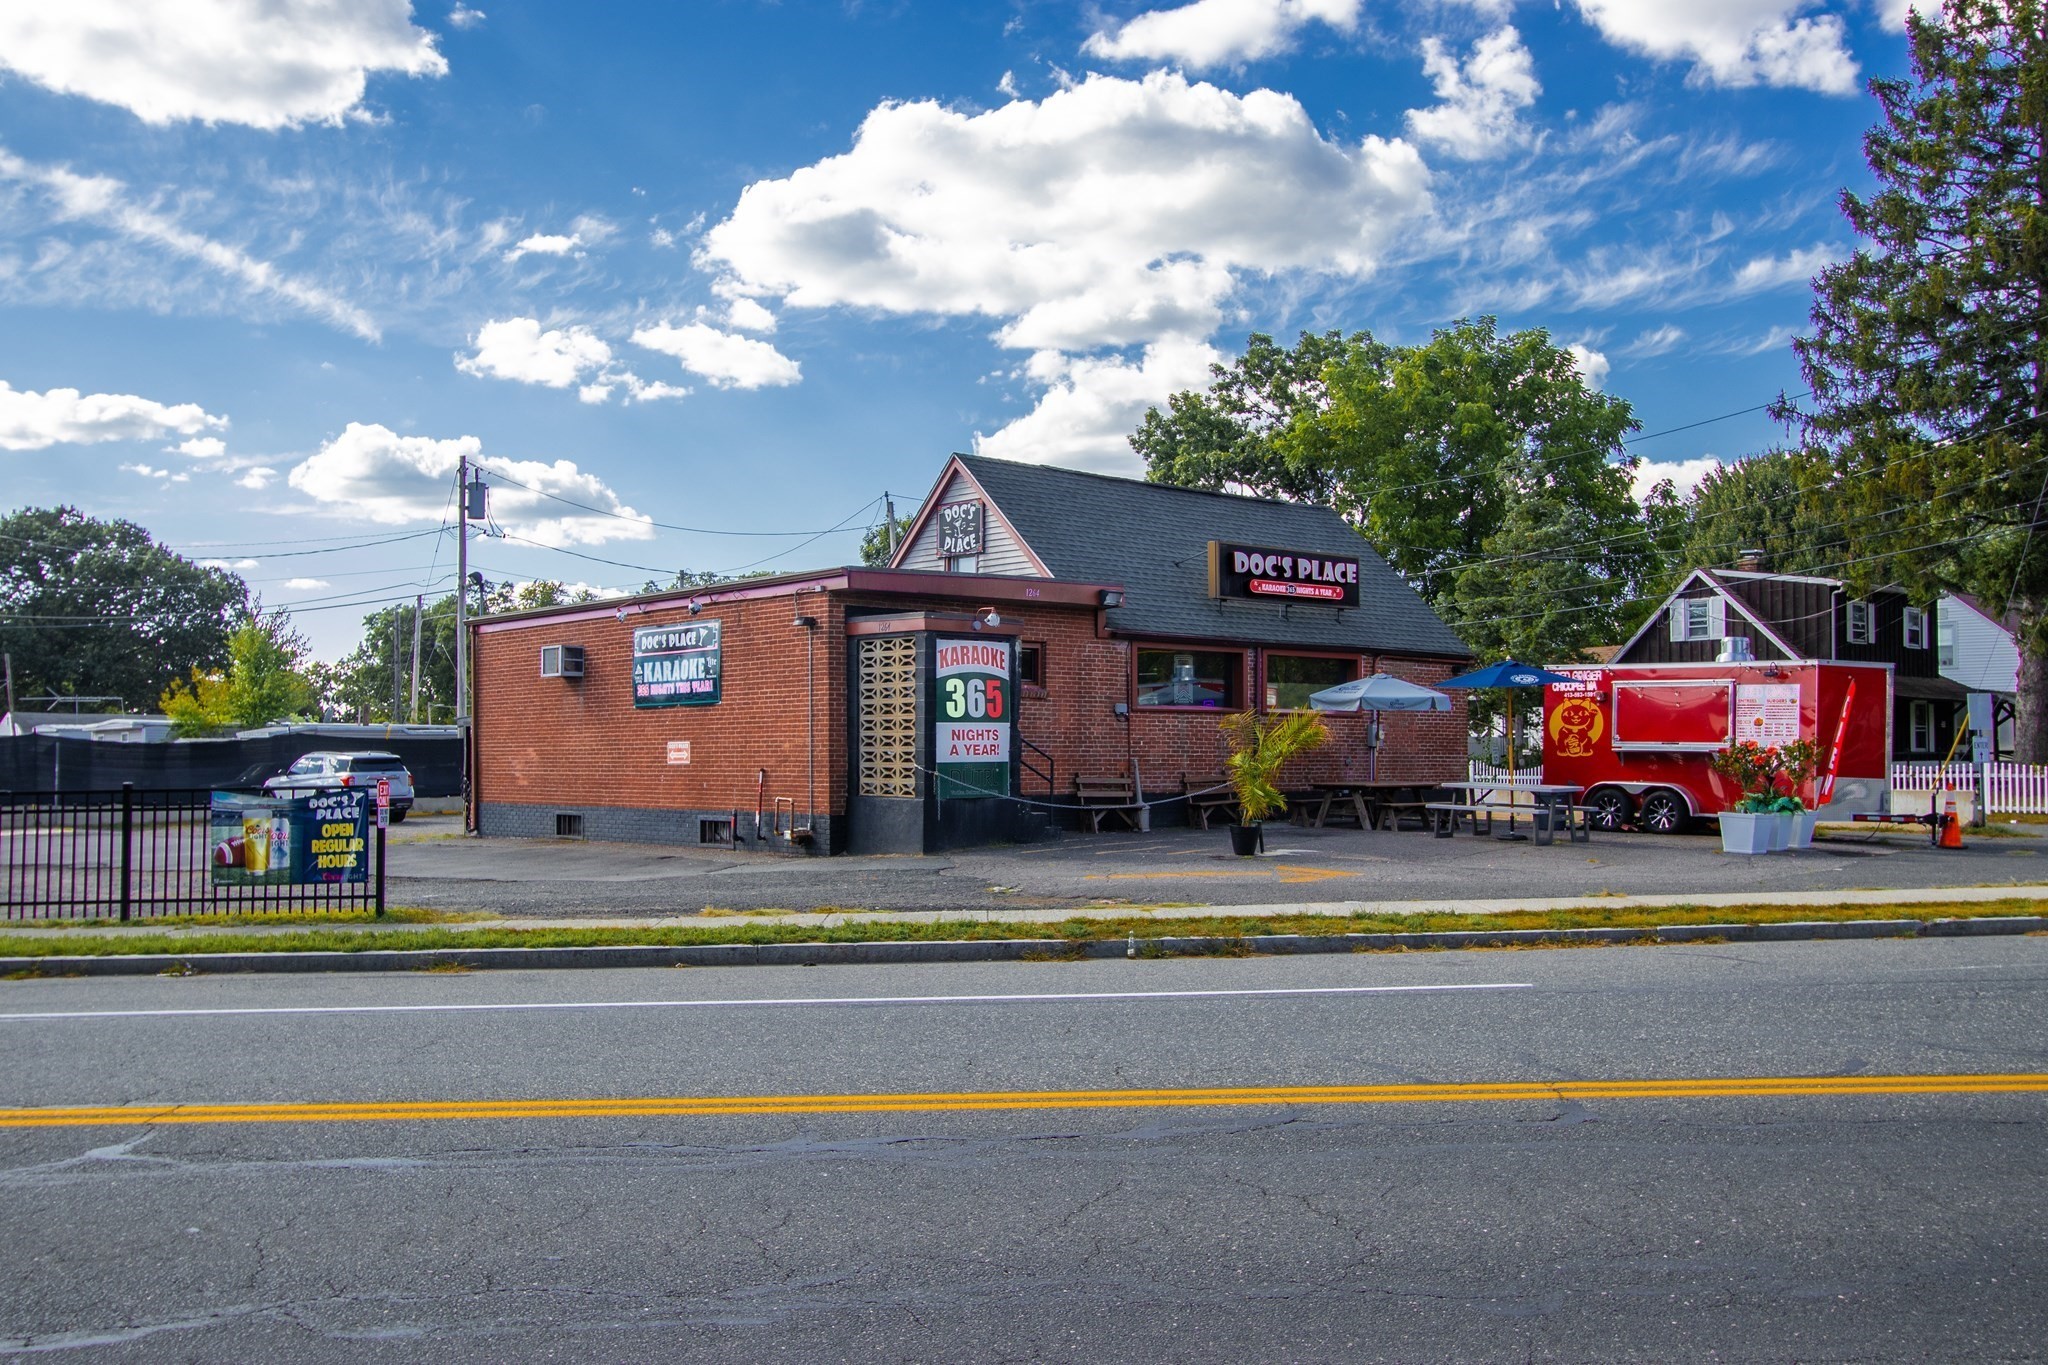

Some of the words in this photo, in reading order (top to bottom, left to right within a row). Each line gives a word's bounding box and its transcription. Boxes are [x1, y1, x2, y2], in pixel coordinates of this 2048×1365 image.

[944, 503, 976, 523] DOC'S
[943, 533, 976, 553] PLACE
[1233, 551, 1293, 578] DOC'S
[1297, 558, 1357, 584] PLACE
[1025, 588, 1040, 598] 1264
[1261, 583, 1286, 593] KARAOKE
[1296, 586, 1314, 596] NIGHTS
[1314, 588, 1320, 596] A
[1320, 589, 1333, 597] YEAR
[641, 633, 667, 650] DOC'S
[668, 631, 697, 648] PLACE
[937, 645, 1006, 671] KARAOKE
[643, 657, 706, 683] KARAOKE
[676, 681, 692, 695] THIS
[945, 678, 1003, 718] 365
[951, 729, 999, 741] NIGHTS
[949, 744, 959, 756] A
[964, 744, 1000, 756] YEAR!
[1974, 741, 1989, 750] ENTER
[379, 784, 389, 796] EXIT
[308, 795, 349, 809] DOC'S
[315, 807, 360, 820] PLACE
[245, 825, 270, 835] Coors
[321, 822, 354, 838] OPEN
[311, 837, 364, 853] REGULAR
[317, 853, 358, 869] HOURS
